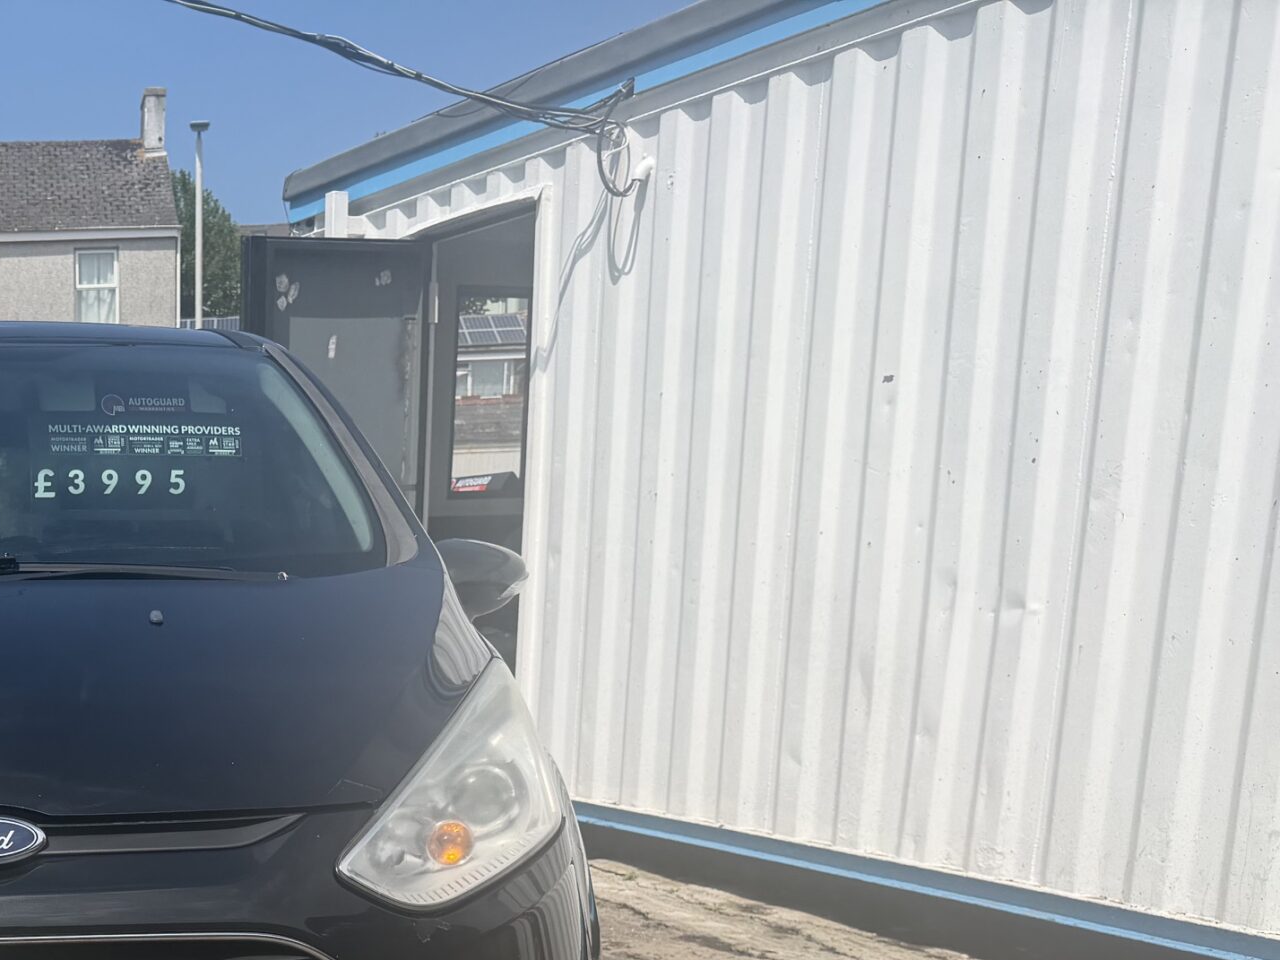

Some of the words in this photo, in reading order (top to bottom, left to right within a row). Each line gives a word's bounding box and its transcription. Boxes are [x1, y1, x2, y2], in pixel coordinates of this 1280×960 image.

[128, 398, 185, 407] AUTOGUARD
[48, 424, 127, 434] MULTI-AWARD
[127, 424, 179, 435] WINNING
[181, 426, 241, 436] PROVIDERS
[51, 444, 88, 453] WINNER
